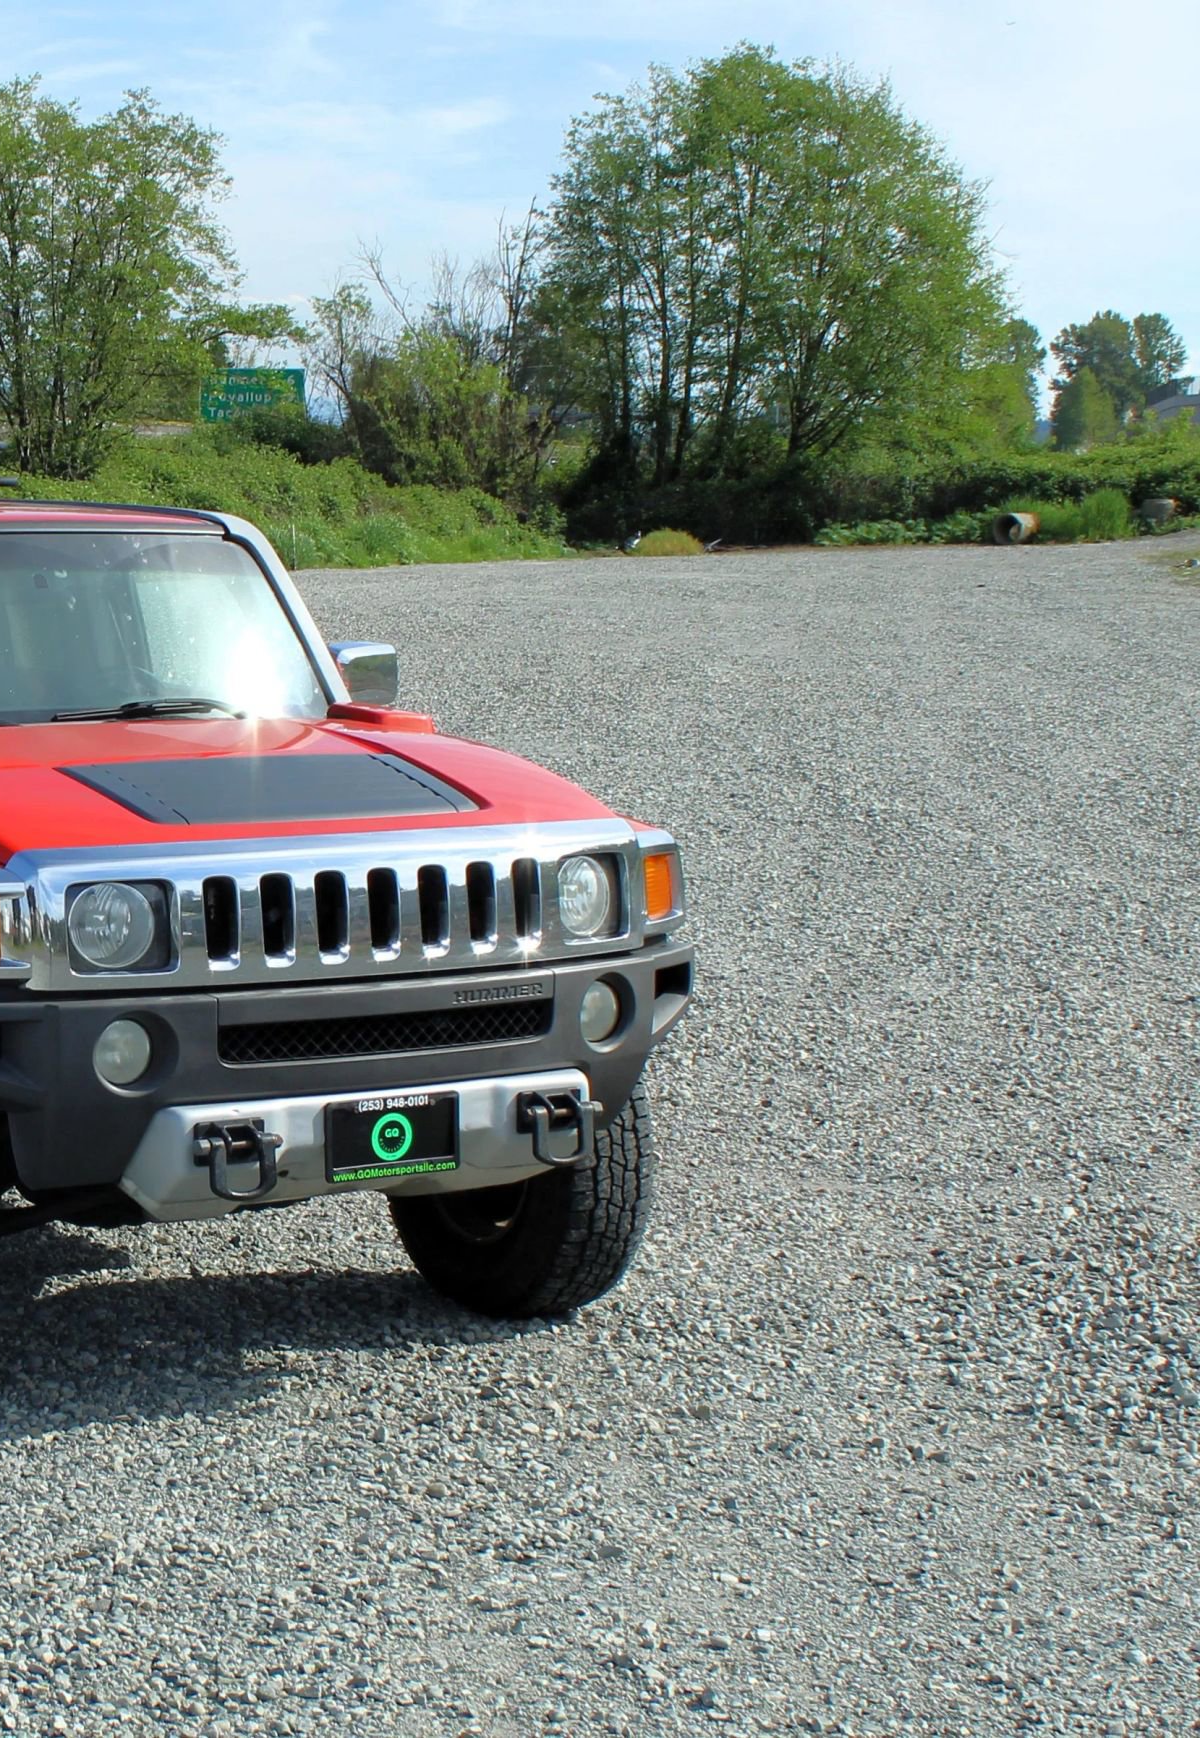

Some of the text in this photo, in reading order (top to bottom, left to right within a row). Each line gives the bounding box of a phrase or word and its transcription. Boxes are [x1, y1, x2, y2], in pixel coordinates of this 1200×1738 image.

[452, 983, 543, 1004] HUMMER
[358, 1095, 429, 1113] (253) 948-0101
[385, 1128, 400, 1138] GQ
[333, 1161, 456, 1182] www.GQMotorsportsllc.com
